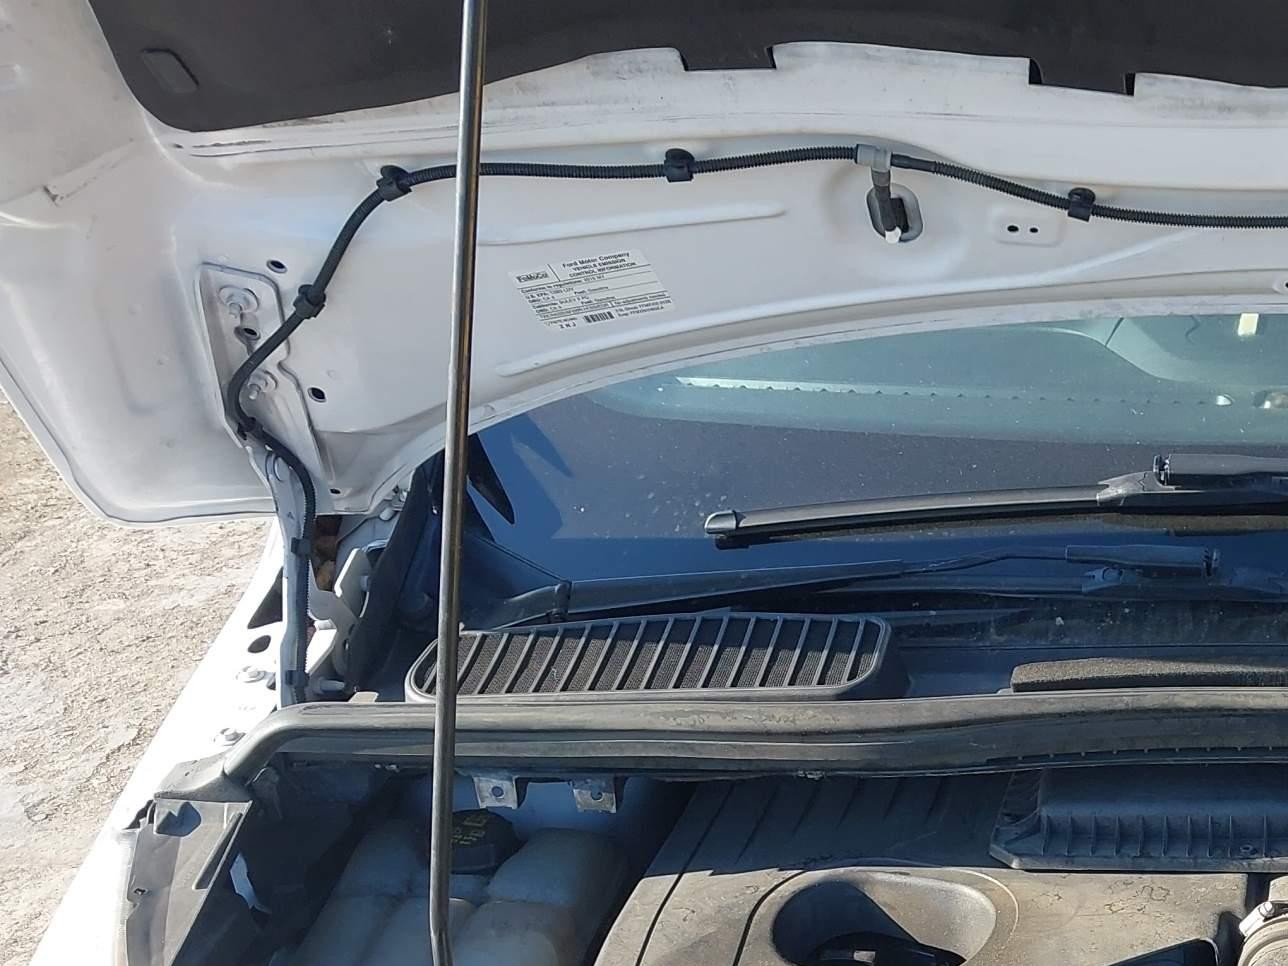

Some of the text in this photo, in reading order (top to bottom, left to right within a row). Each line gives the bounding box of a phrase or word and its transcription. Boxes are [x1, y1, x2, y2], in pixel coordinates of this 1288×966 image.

[562, 252, 630, 268] Ford Motor Company
